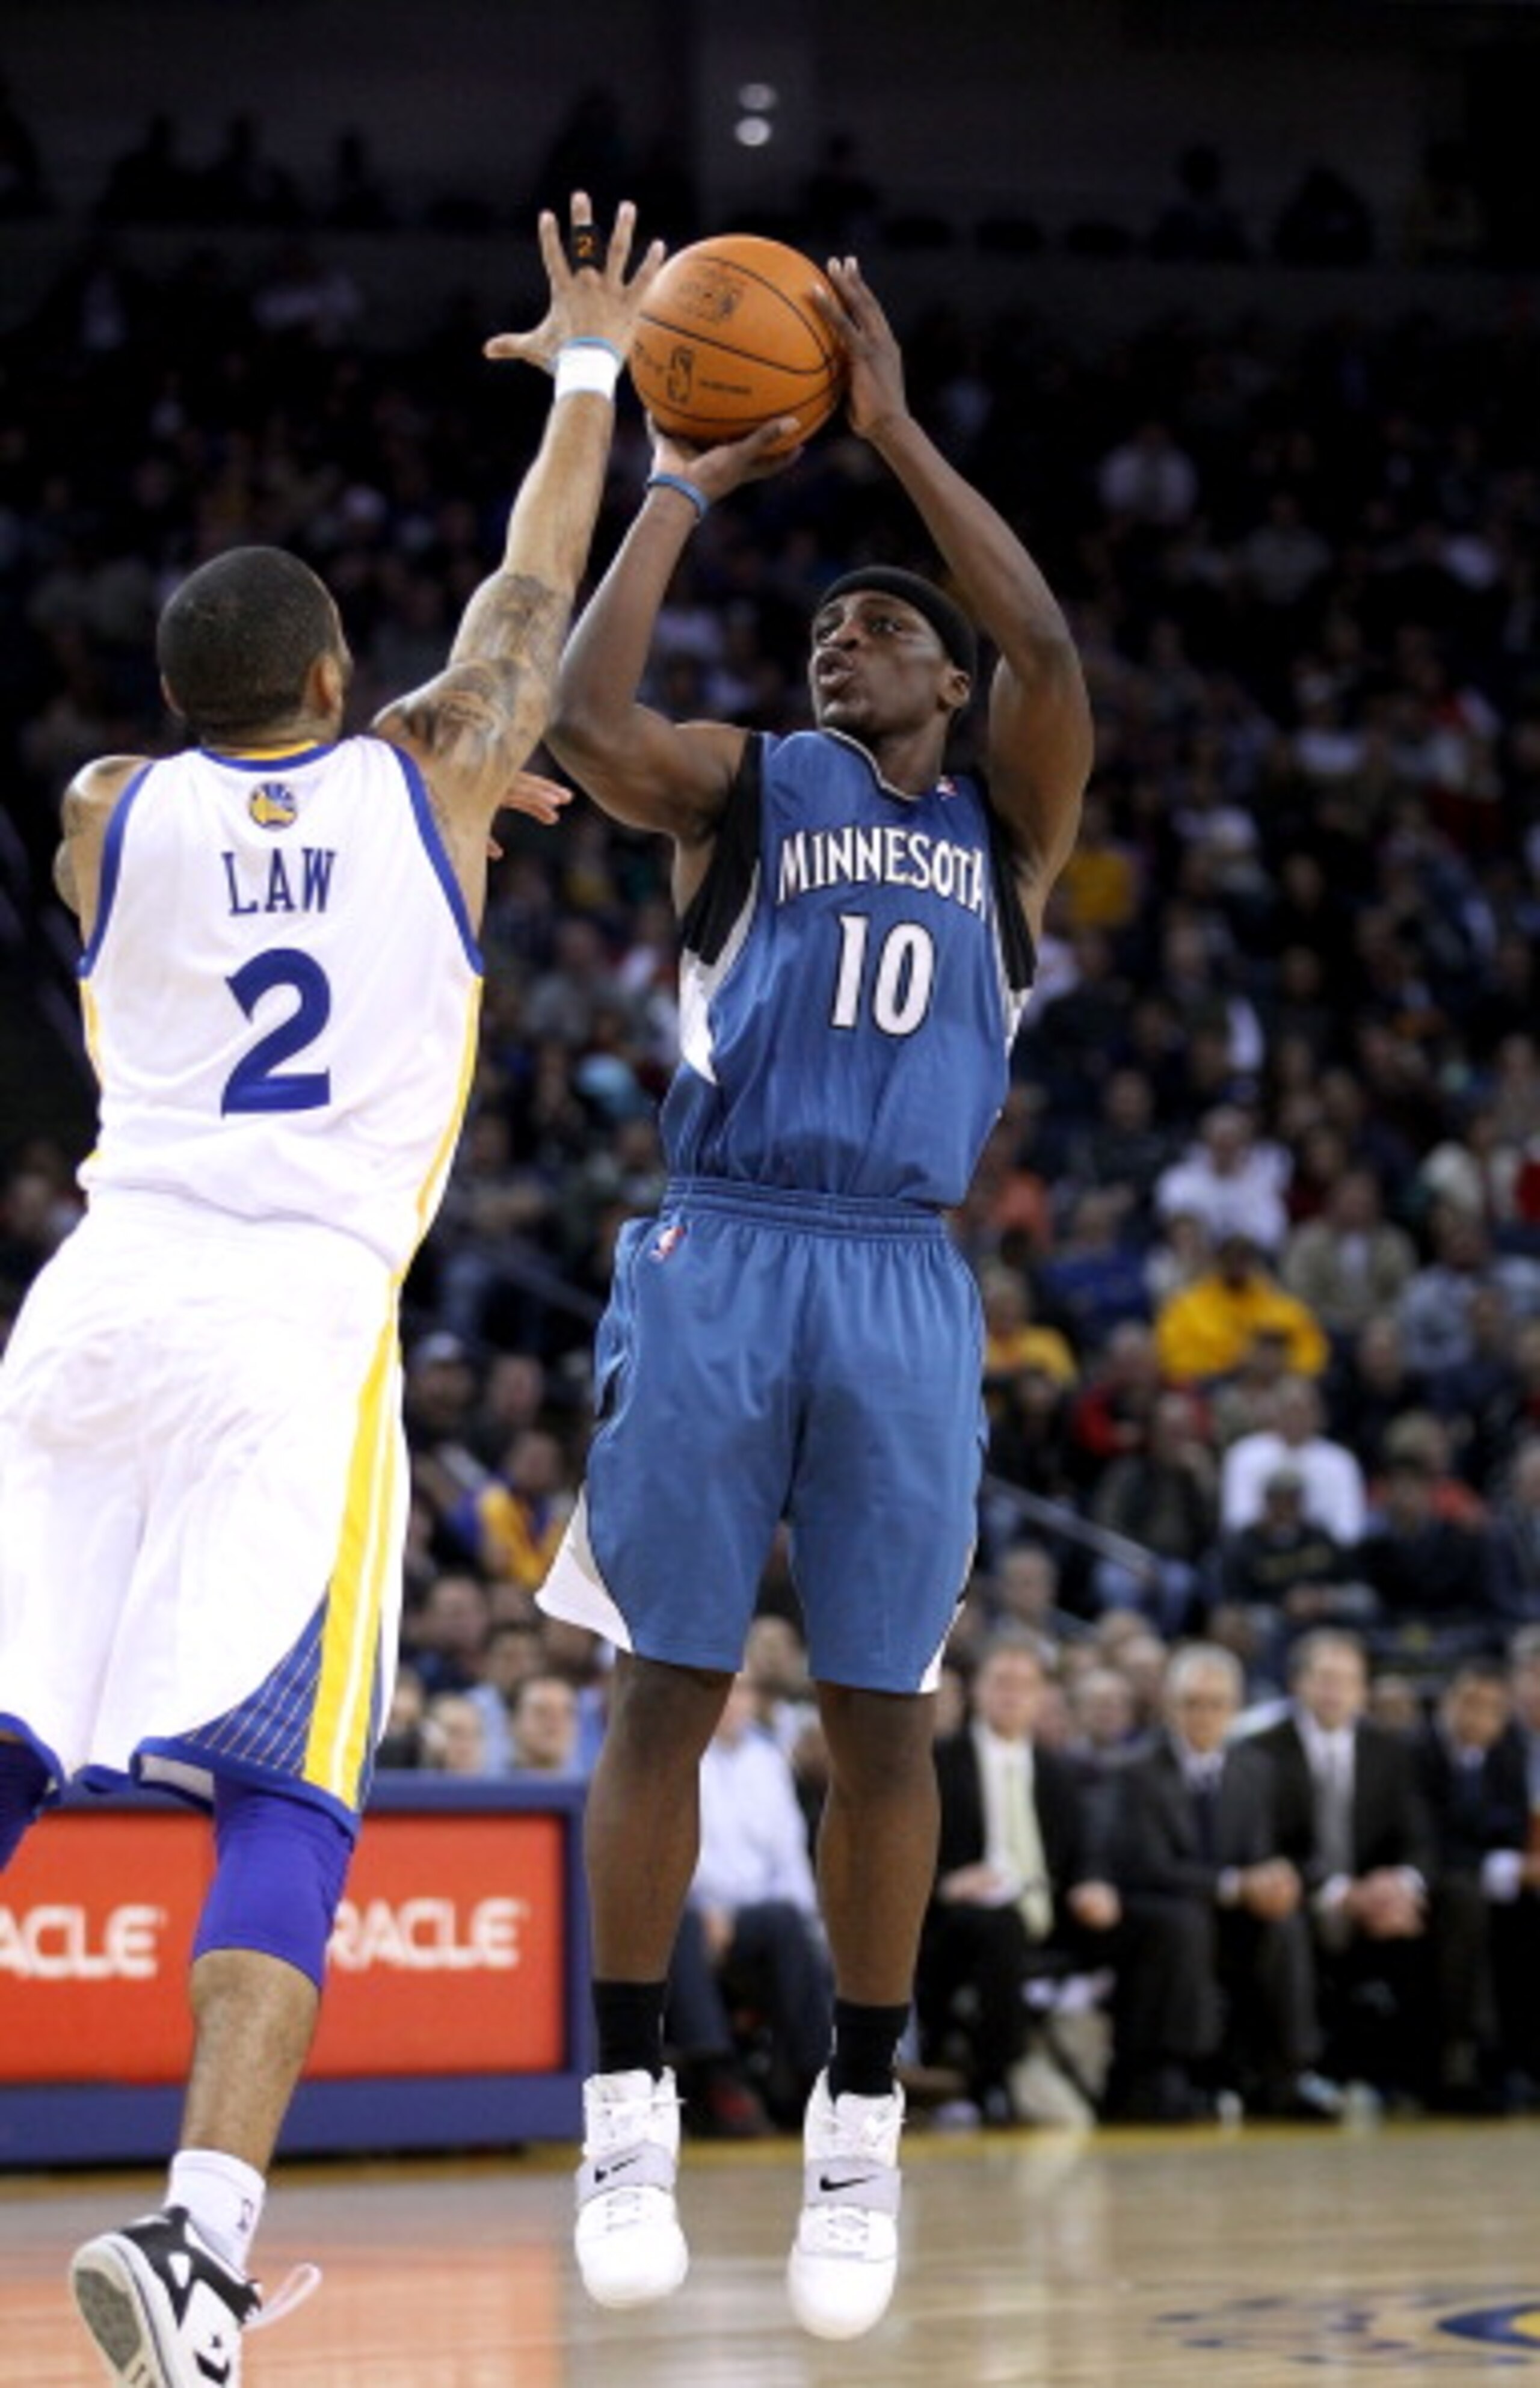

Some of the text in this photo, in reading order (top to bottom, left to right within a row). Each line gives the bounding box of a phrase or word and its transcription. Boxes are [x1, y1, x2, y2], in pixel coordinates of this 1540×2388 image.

[577, 235, 595, 257] 2
[221, 847, 336, 916] LAW
[776, 825, 987, 921] MINNESOTA
[831, 912, 935, 1037] 10
[221, 947, 331, 1119] 2
